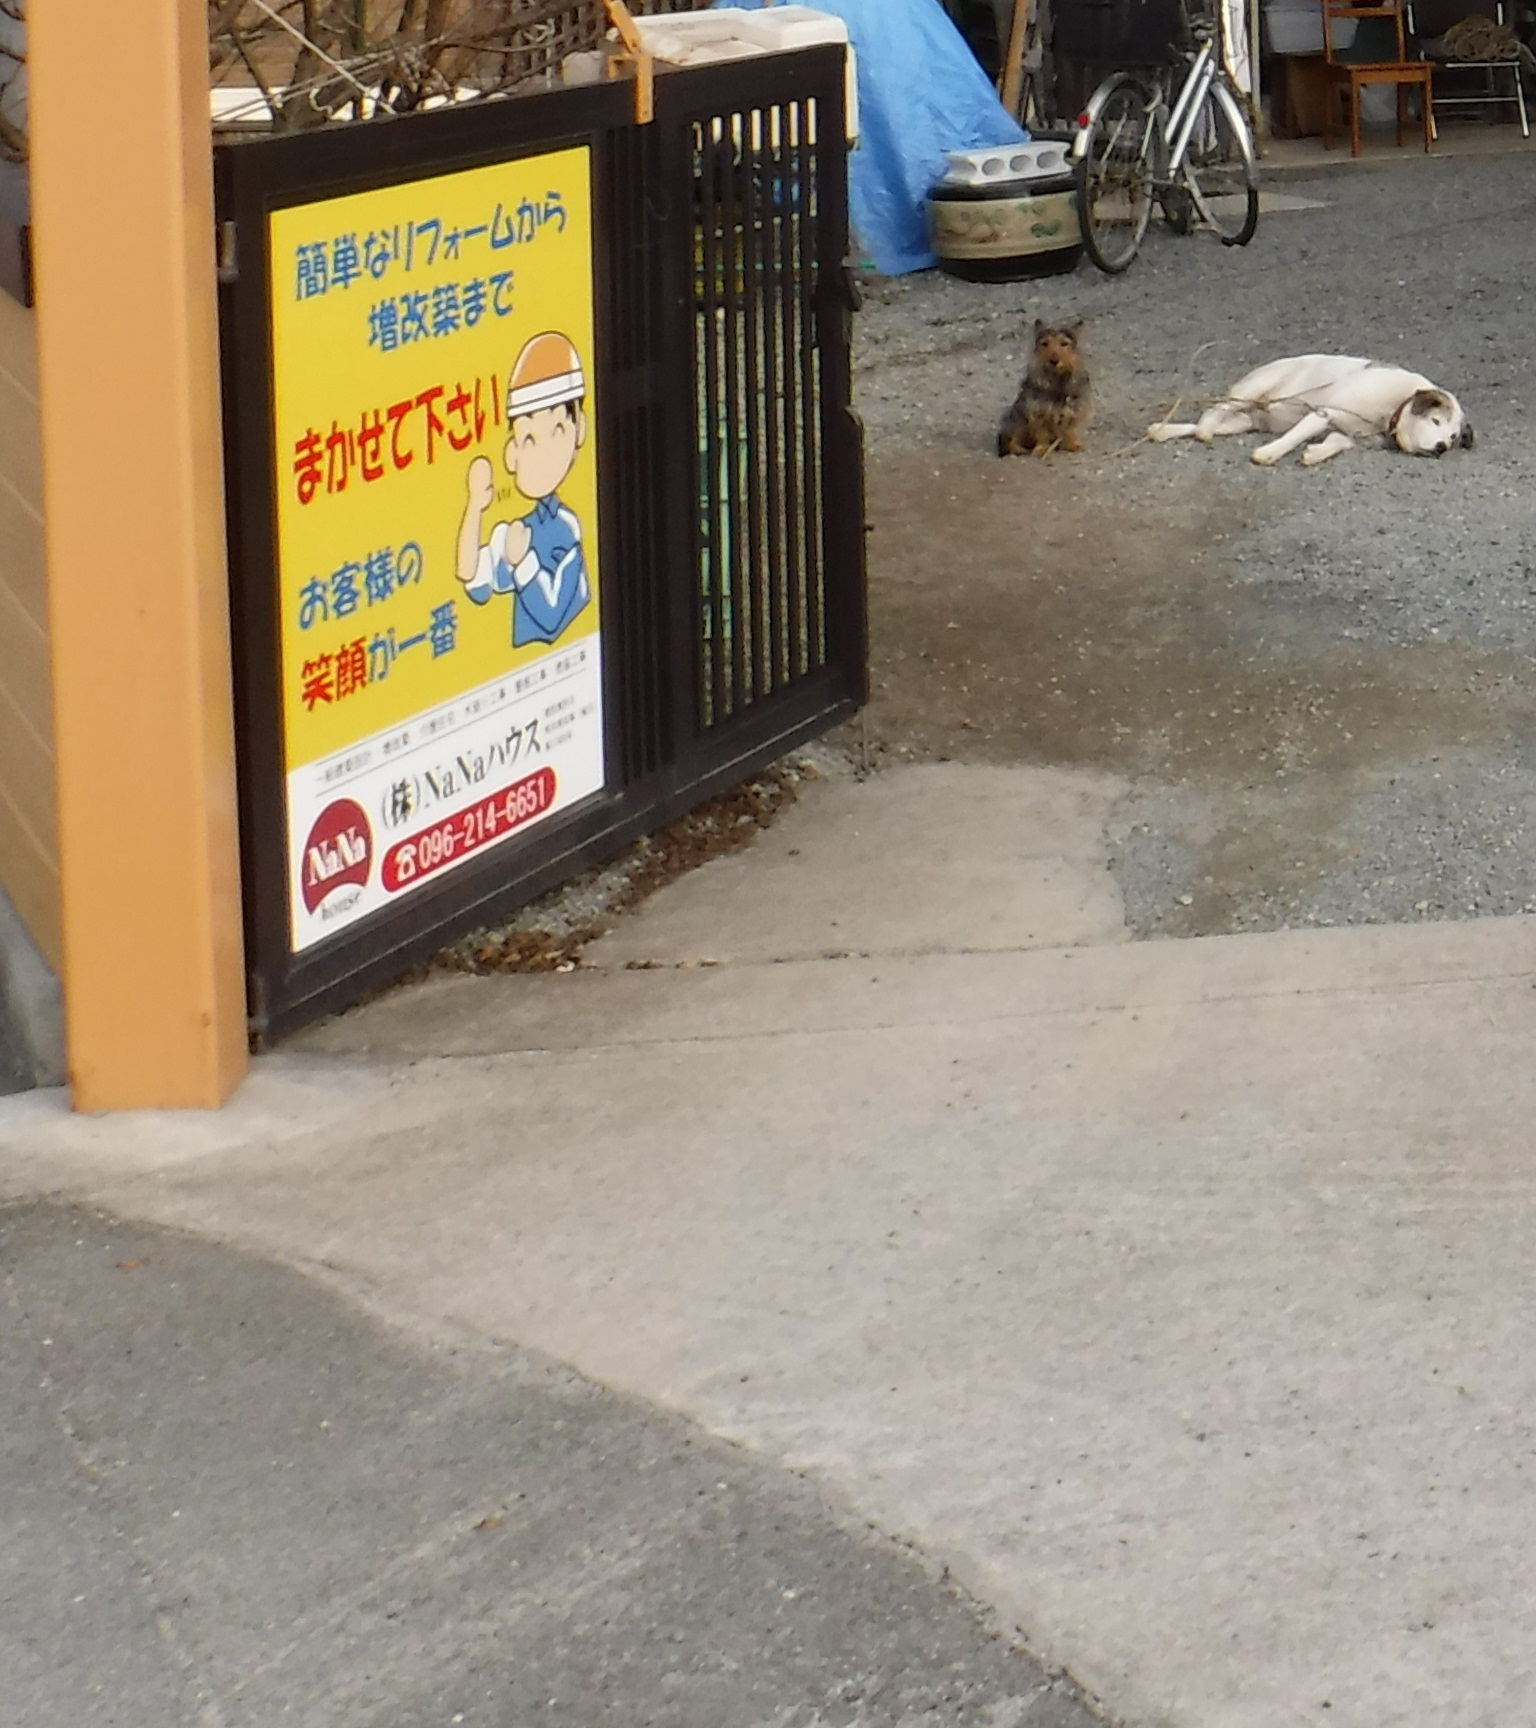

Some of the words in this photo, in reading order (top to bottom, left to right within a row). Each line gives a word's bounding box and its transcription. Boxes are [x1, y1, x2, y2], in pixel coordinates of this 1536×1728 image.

[295, 191, 568, 301] 簡単なリフォームから
[368, 270, 514, 352] 増改築まで
[293, 374, 500, 506] まかせて下さい
[299, 541, 423, 630] お客様の
[301, 599, 459, 712] 笑顔が一番
[308, 826, 368, 887] NaNa
[418, 774, 547, 870] 096-214-6651
